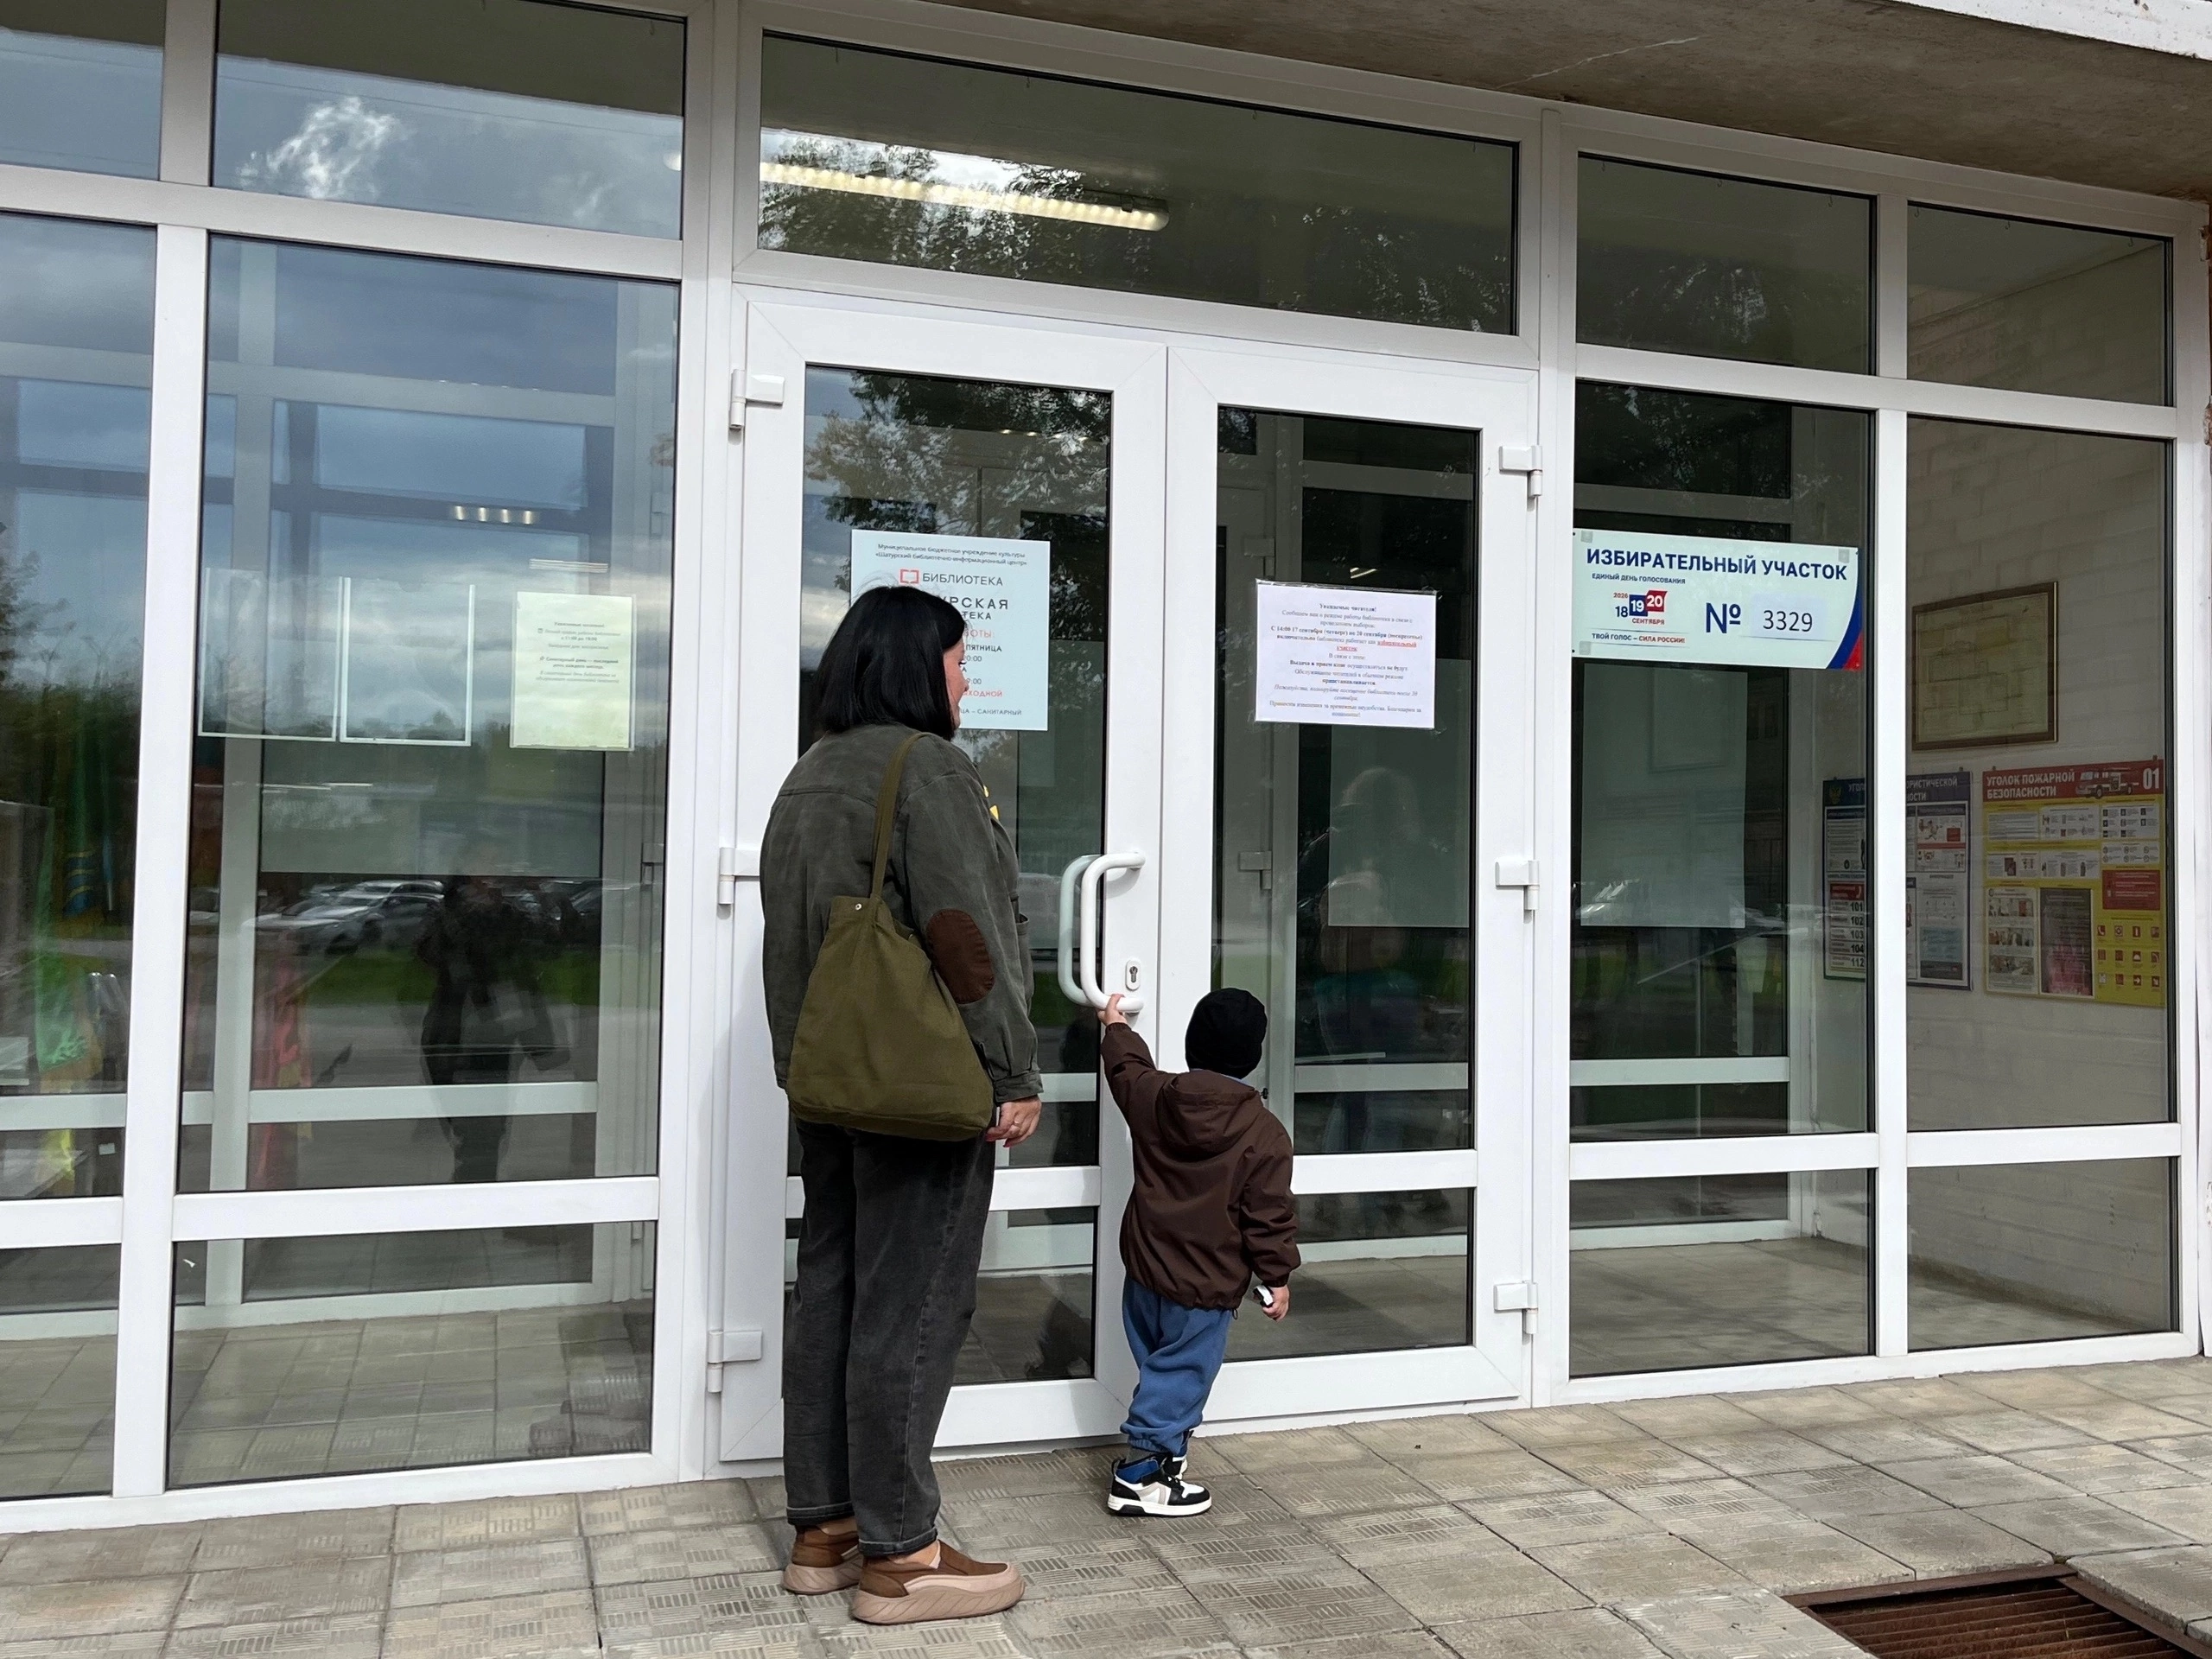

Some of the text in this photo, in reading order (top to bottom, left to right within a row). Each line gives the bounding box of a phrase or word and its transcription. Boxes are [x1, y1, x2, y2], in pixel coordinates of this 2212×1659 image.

[1586, 548, 1847, 581] ИЗБИРАТЕЛЬНЫЙ УЧАСТОК
[922, 572, 1003, 586] БИБЛИОТЕКА
[1639, 575, 1686, 584] ГОЛОСОВАНИЯ
[944, 596, 1008, 610] РСКАЯ
[1615, 594, 1663, 618] 18 19 20
[962, 611, 991, 620] ТЕКА
[1705, 603, 1813, 633] № 3329
[965, 644, 1002, 652] ПЯТНИЦА
[1986, 767, 2160, 790] УГОЛОК ПОЖАРНОЙ 01
[1987, 785, 2056, 799] БЕЗОПАСНОСТИ
[1851, 901, 1864, 912] 101
[1851, 916, 1864, 926] 102
[1851, 930, 1864, 940] 103
[1851, 957, 1865, 967] 112
